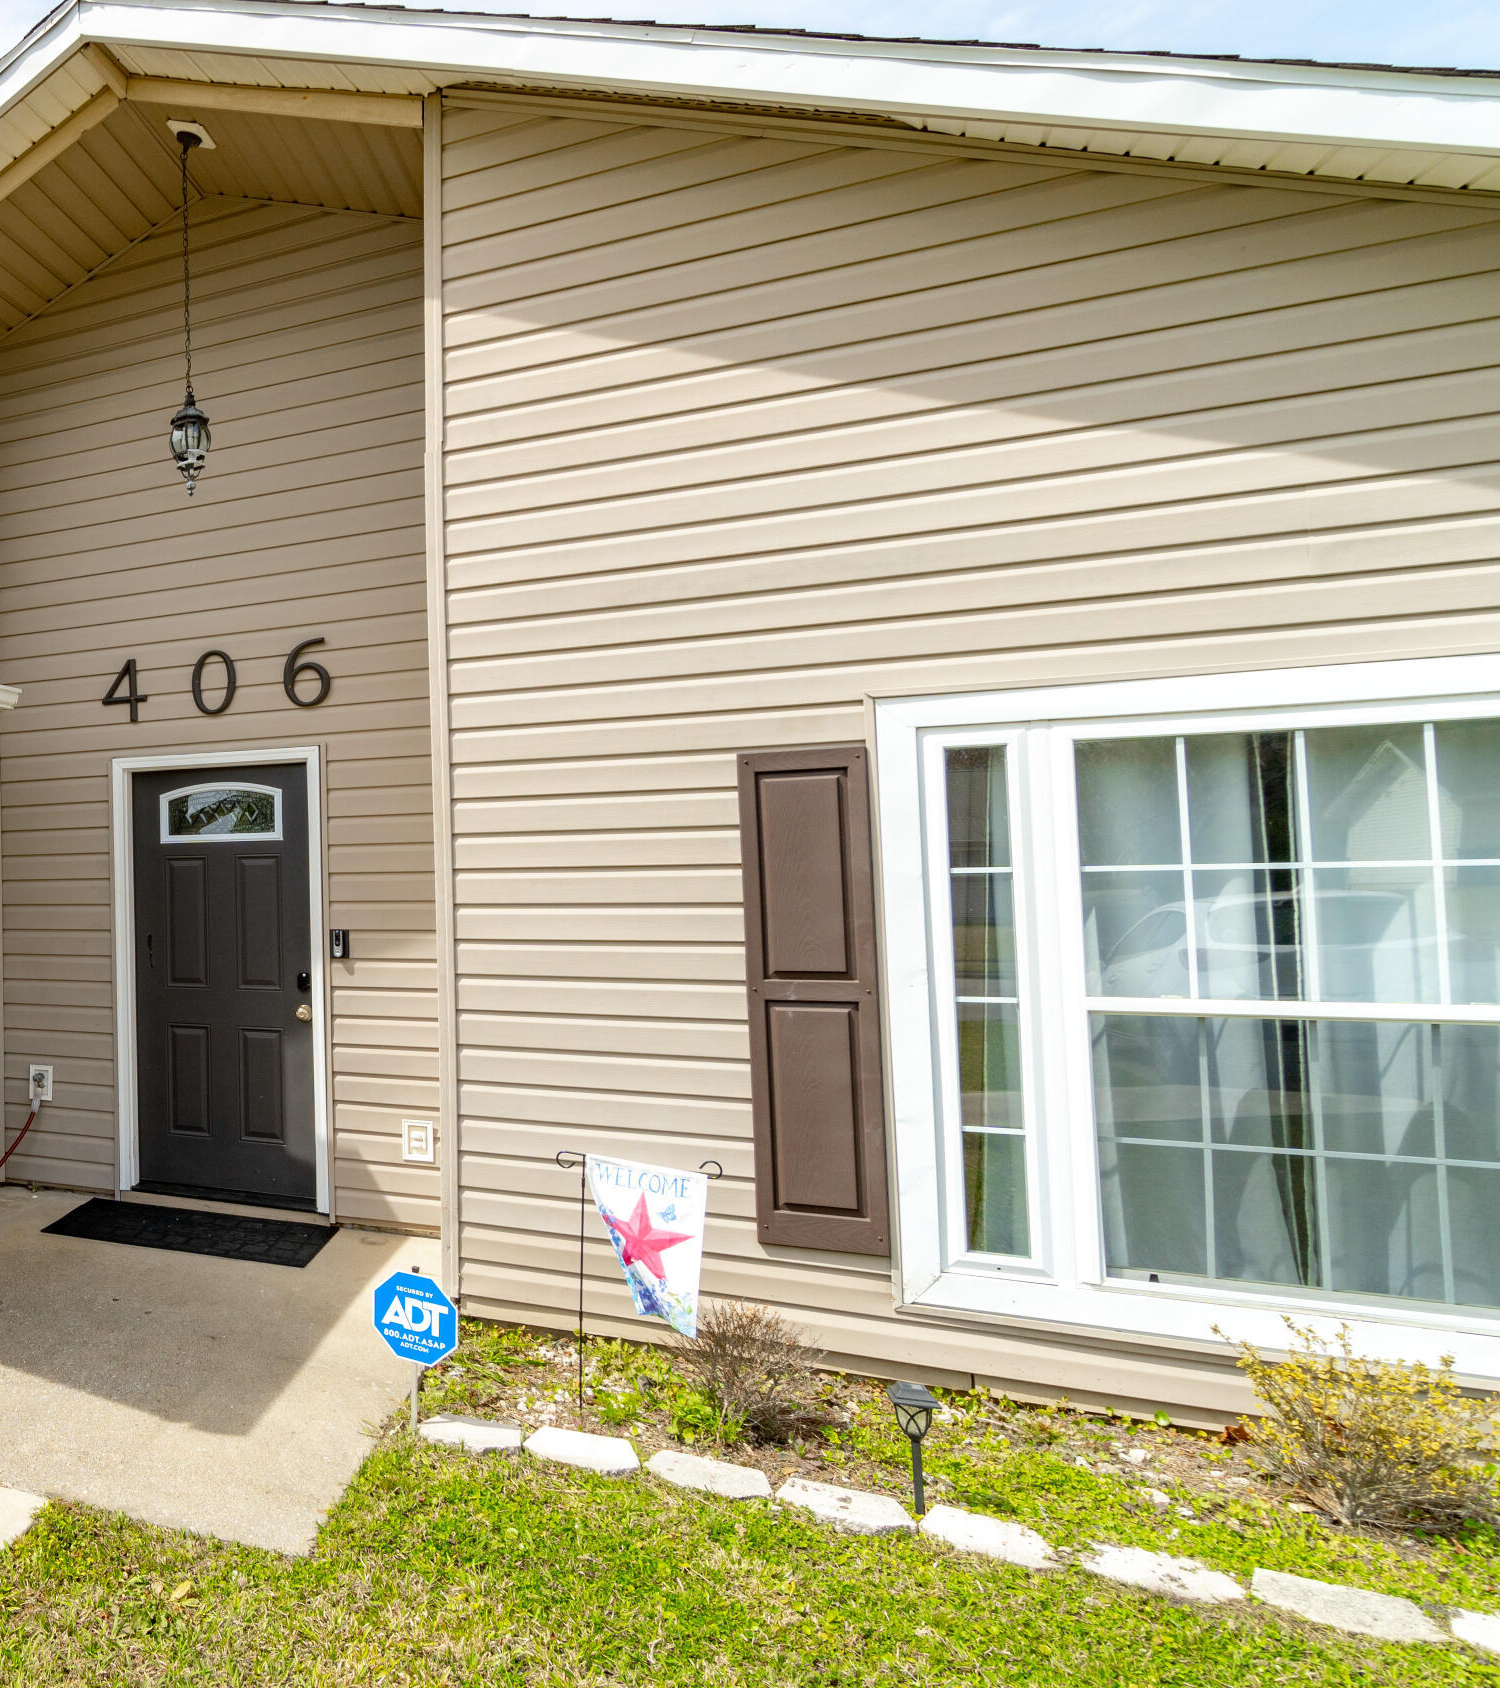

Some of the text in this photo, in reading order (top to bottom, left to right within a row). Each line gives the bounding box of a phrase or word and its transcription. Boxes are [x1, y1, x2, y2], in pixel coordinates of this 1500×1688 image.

[102, 637, 331, 722] 406
[595, 1163, 693, 1199] WELCOME
[396, 1285, 434, 1299] SECURED BY
[381, 1294, 449, 1338] ADT
[400, 1341, 429, 1354] ADT.COM
